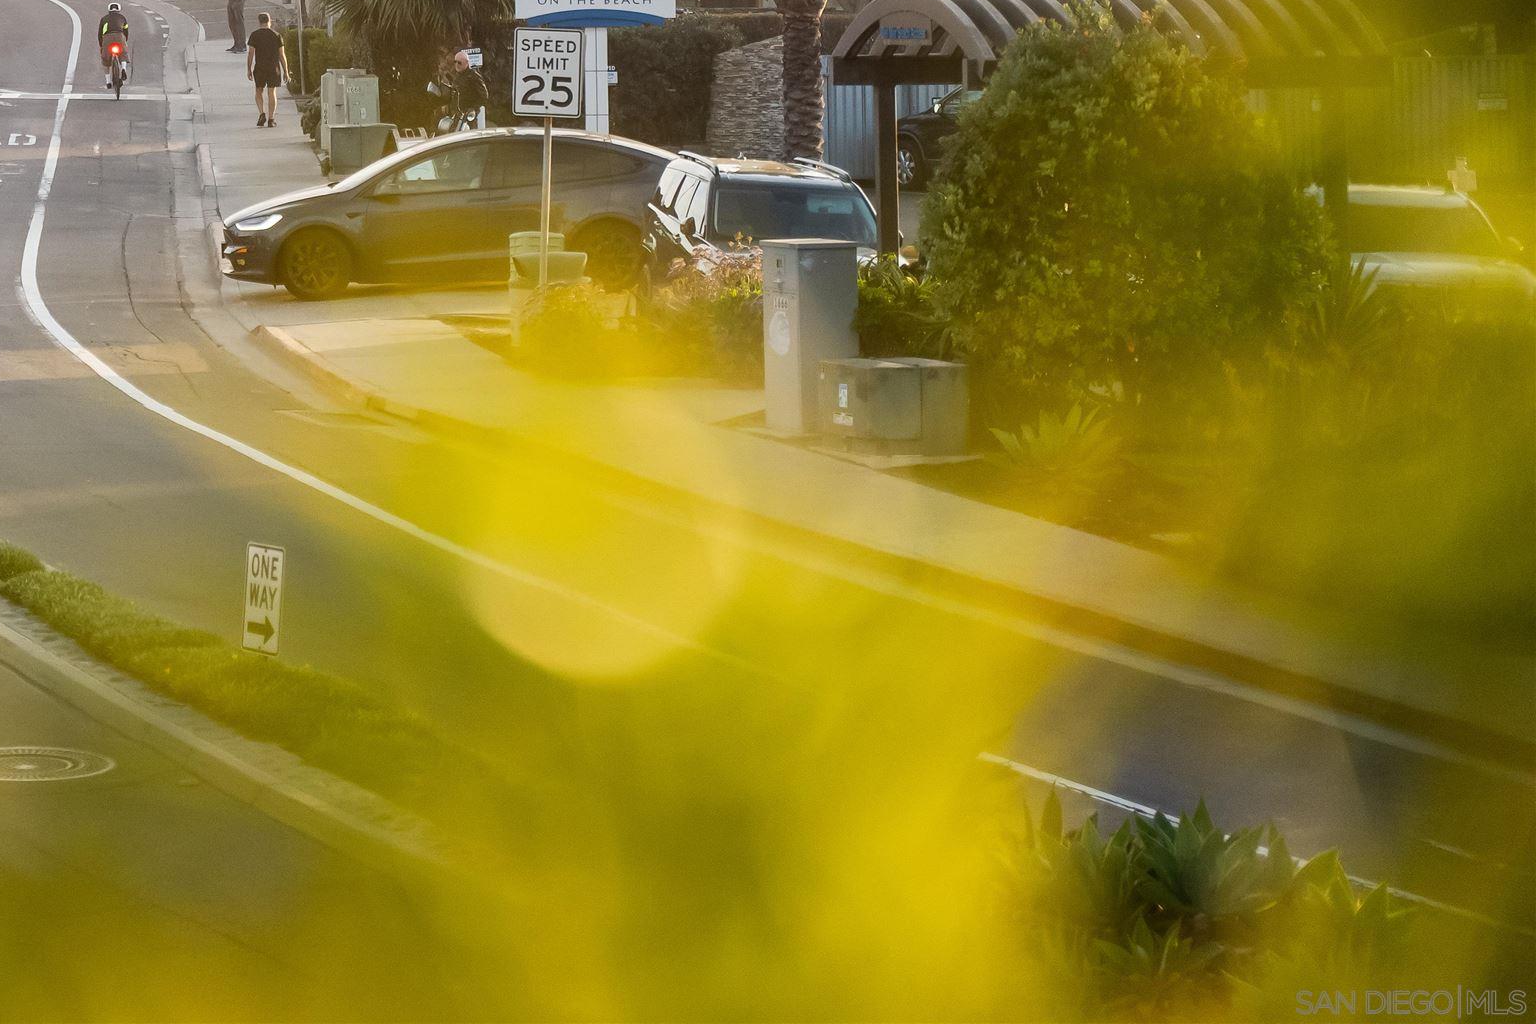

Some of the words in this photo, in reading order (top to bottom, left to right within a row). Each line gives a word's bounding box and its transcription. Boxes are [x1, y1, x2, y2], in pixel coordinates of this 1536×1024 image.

[521, 39, 577, 53] SPEED
[527, 57, 569, 71] LIMIT
[521, 75, 574, 108] 25
[251, 553, 279, 581] ONE
[249, 582, 277, 611] WAY
